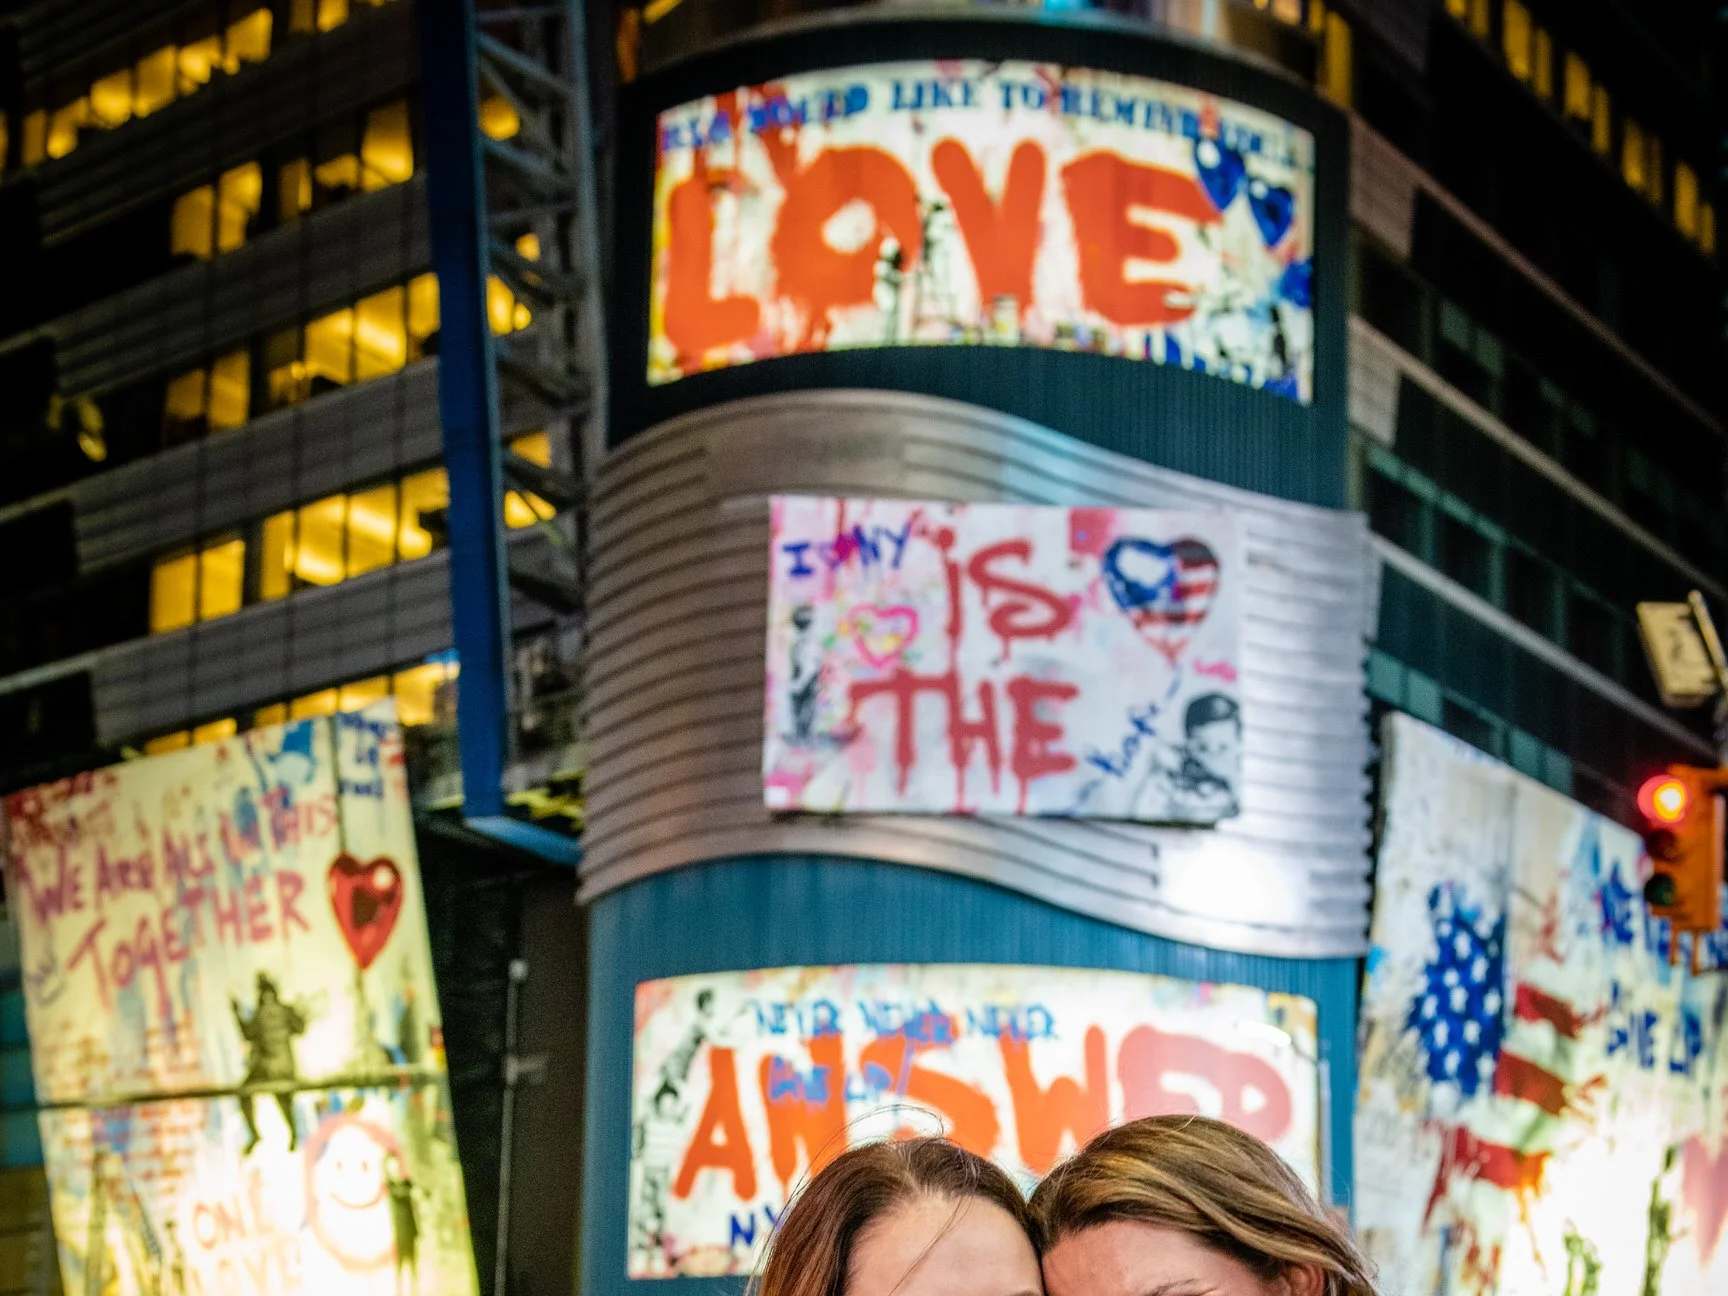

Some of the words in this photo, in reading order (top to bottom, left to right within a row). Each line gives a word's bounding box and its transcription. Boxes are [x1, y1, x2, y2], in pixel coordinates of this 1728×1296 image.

[663, 136, 1222, 366] LOVE
[848, 667, 1080, 788] THE
[67, 868, 312, 1004] TOGETHER
